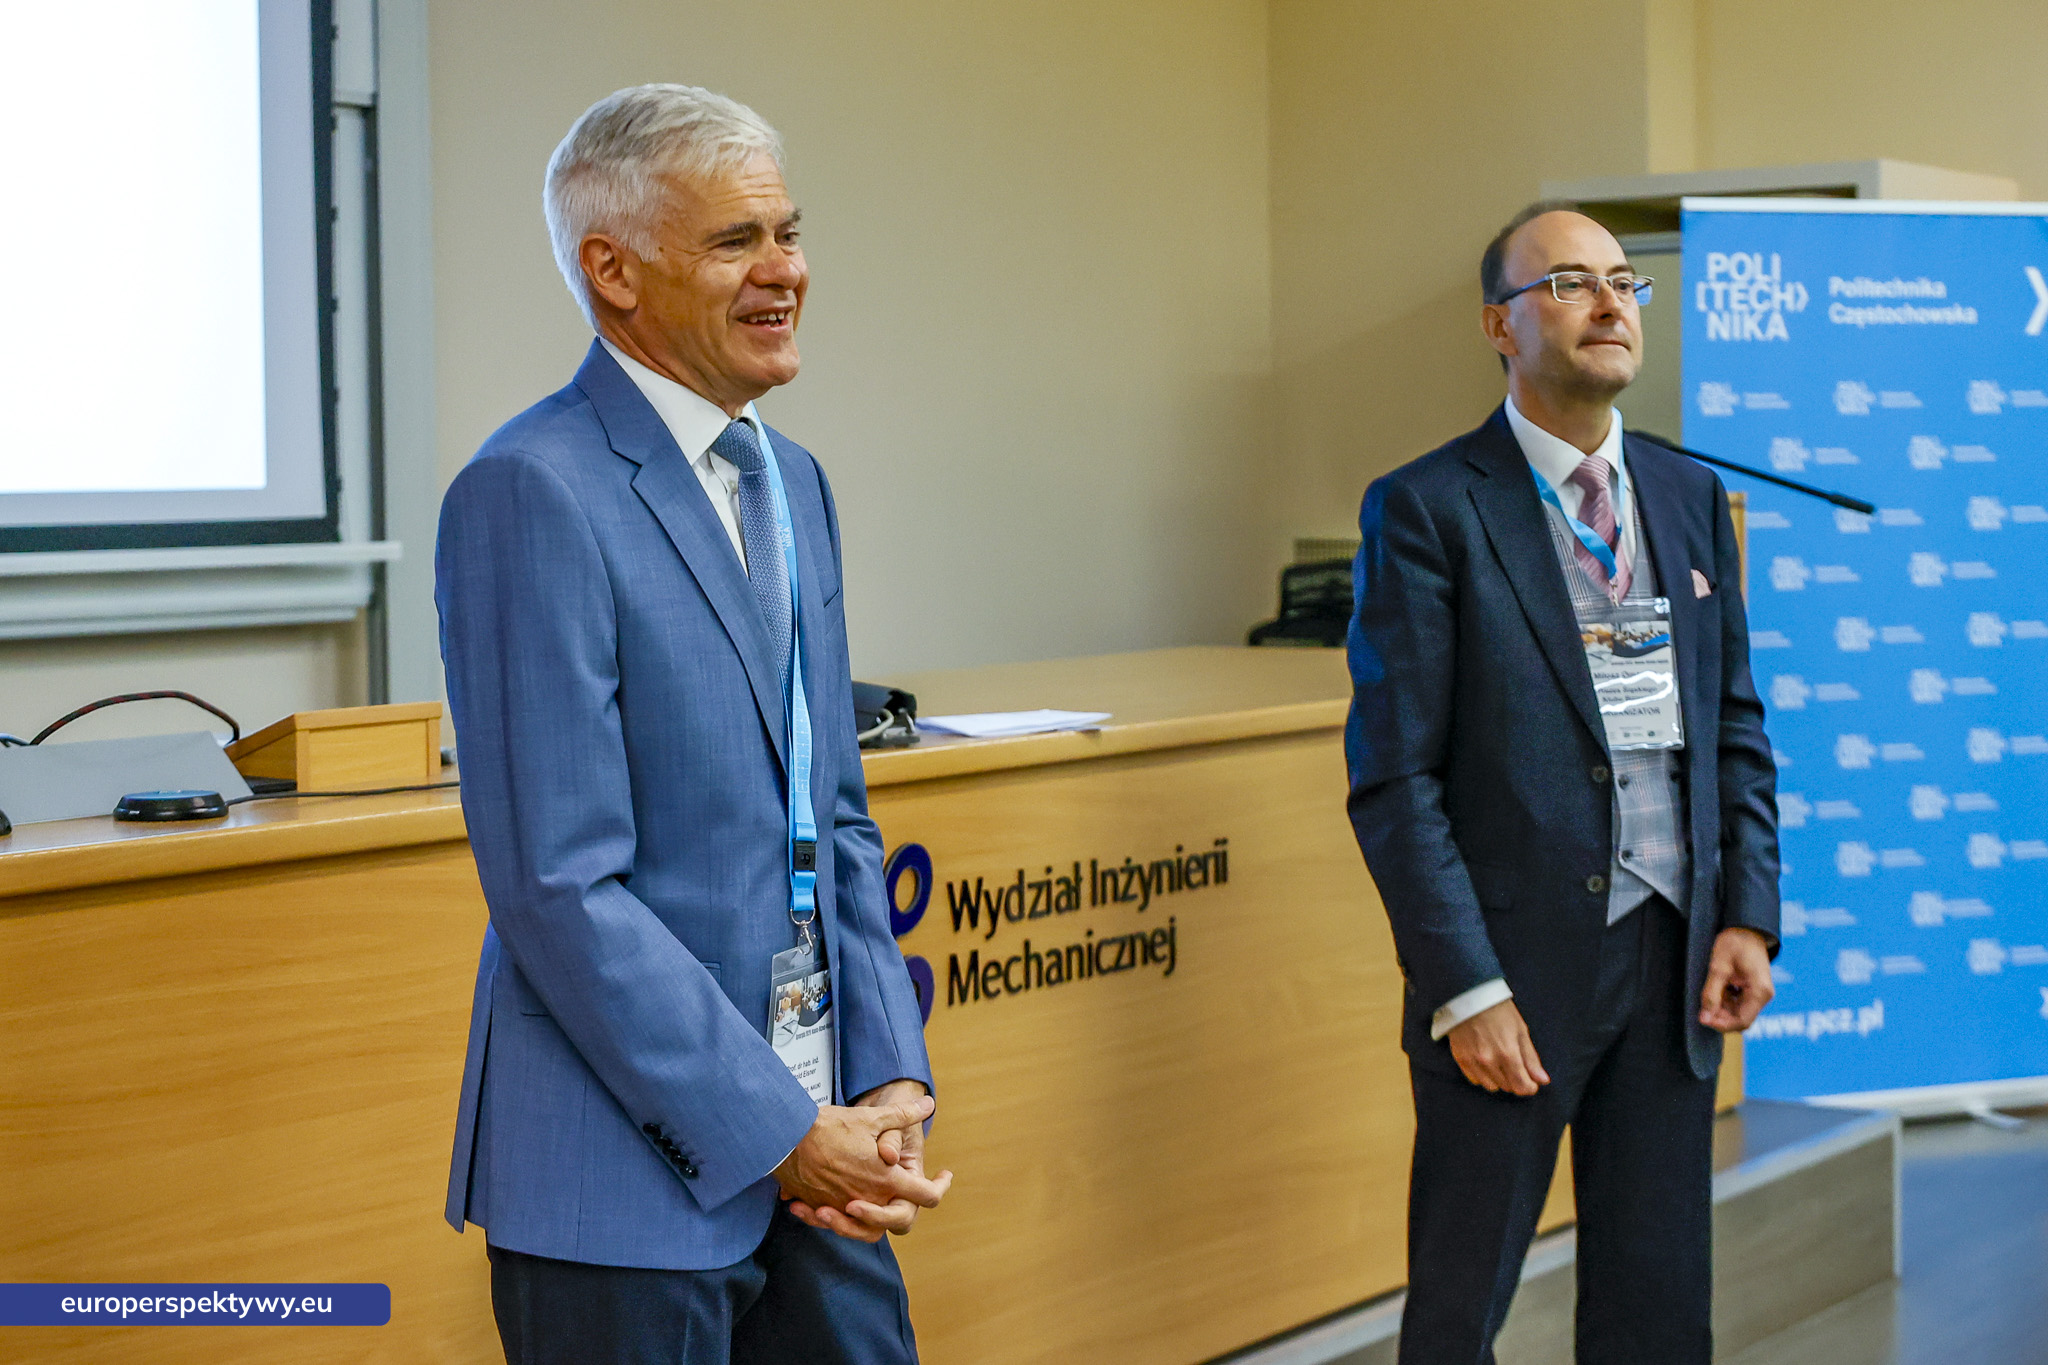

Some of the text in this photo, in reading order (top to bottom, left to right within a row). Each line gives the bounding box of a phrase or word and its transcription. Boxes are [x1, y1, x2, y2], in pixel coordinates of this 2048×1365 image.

[1707, 252, 1782, 282] POLI
[1707, 311, 1790, 341] NIKA
[947, 838, 1228, 941] Wydział Inżynierii
[947, 916, 1176, 1007] Mechanicznej
